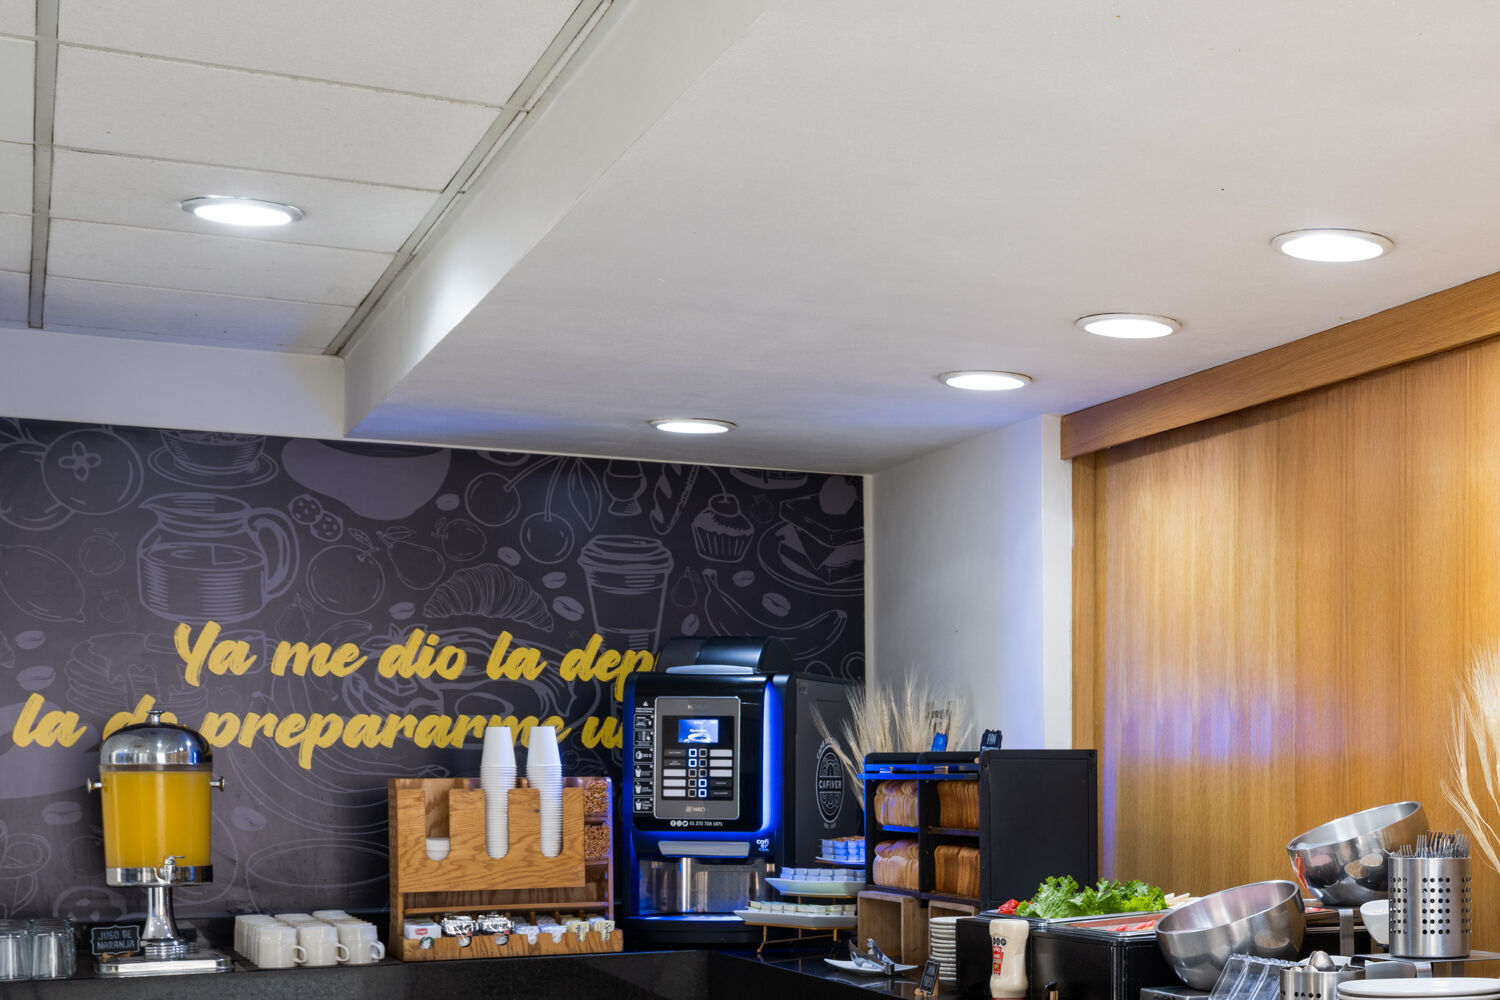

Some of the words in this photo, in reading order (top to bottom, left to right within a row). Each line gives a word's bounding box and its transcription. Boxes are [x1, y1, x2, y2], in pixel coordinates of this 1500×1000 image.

[174, 620, 257, 687] Ya
[271, 640, 368, 678] me
[378, 628, 467, 680] dio
[486, 630, 548, 681] la
[560, 633, 660, 702] dep
[12, 692, 87, 748] la
[581, 716, 623, 749] u
[818, 780, 842, 789] CAFIVER
